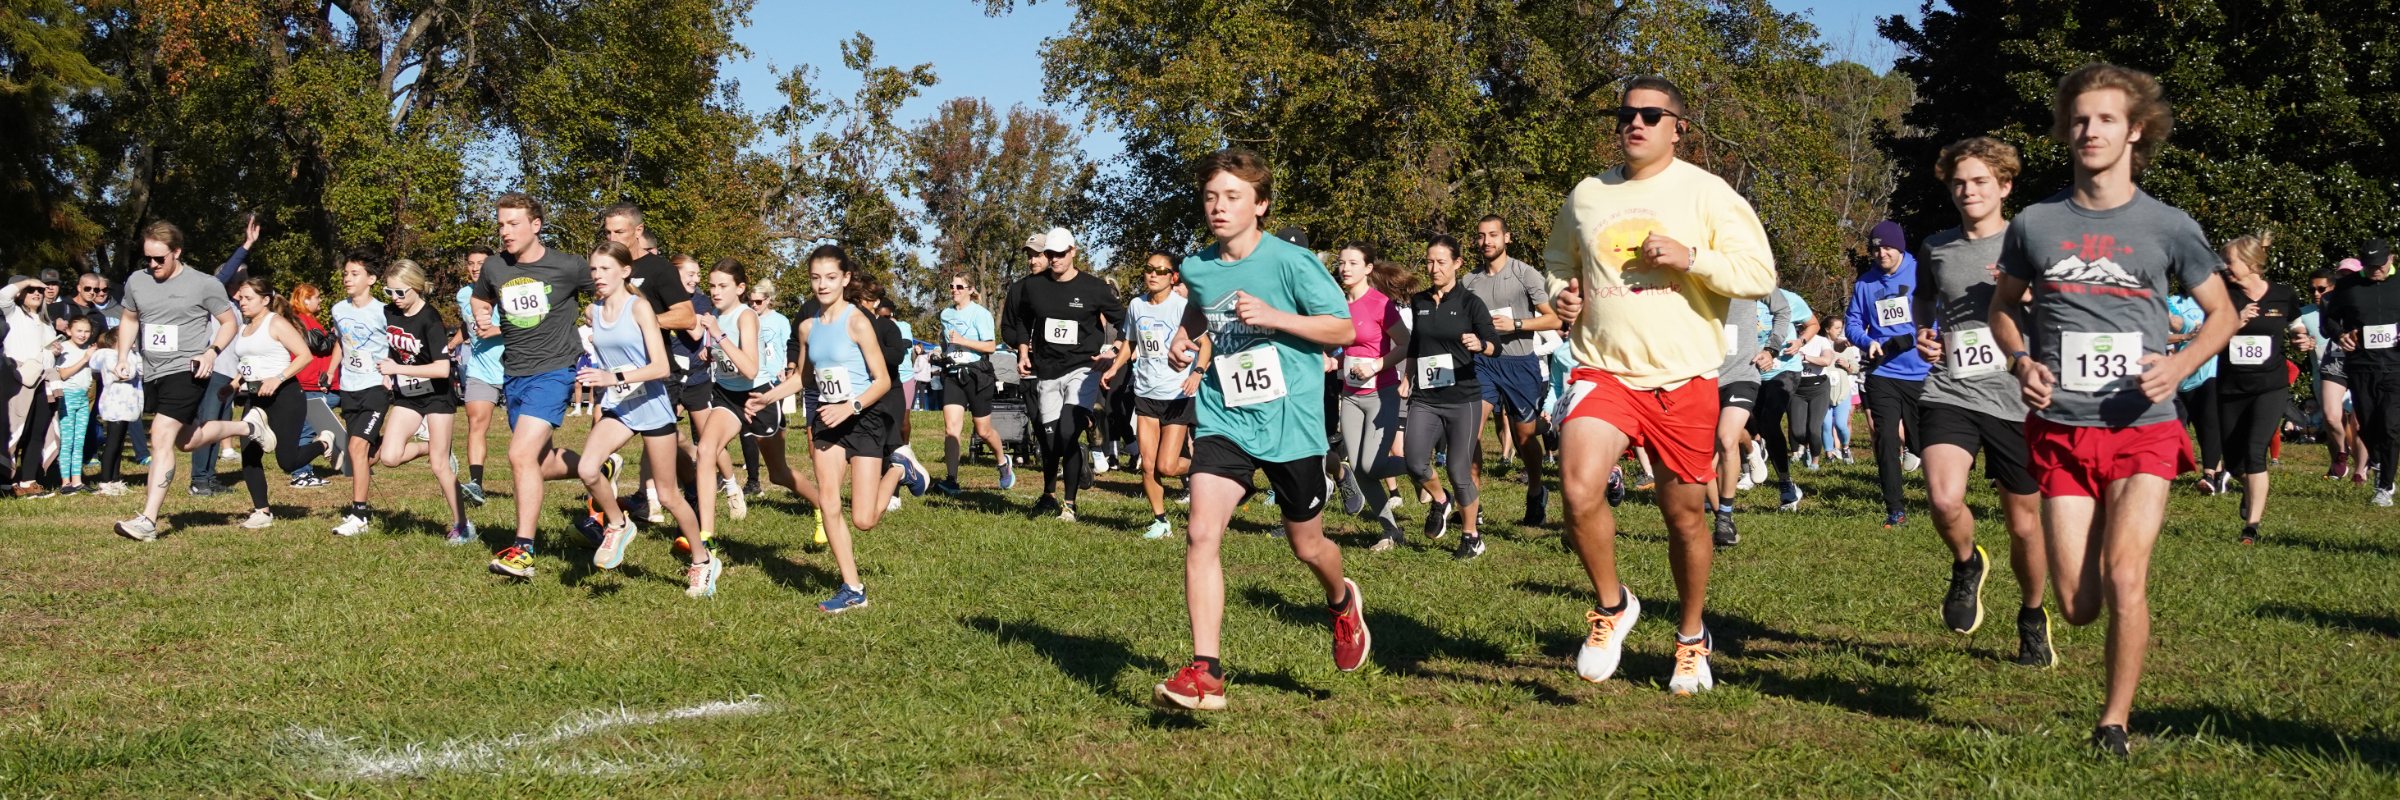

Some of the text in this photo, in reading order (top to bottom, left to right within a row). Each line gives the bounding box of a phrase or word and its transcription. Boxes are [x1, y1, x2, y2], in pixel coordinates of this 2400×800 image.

[511, 294, 539, 310] 198
[1883, 306, 1904, 320] 209
[152, 334, 167, 345] 24
[1054, 327, 1068, 338] 87
[2370, 333, 2391, 343] 208
[386, 332, 421, 355] RUN
[1142, 339, 1160, 352] 190
[1953, 344, 1994, 367] 126
[2238, 346, 2263, 358] 188
[349, 356, 363, 368] 25
[720, 359, 735, 373] 03
[2076, 353, 2128, 378] 133
[241, 365, 252, 376] 23
[1426, 367, 1441, 381] 97
[405, 378, 422, 391] 72
[819, 379, 842, 395] 201
[1231, 367, 1271, 393] 145
